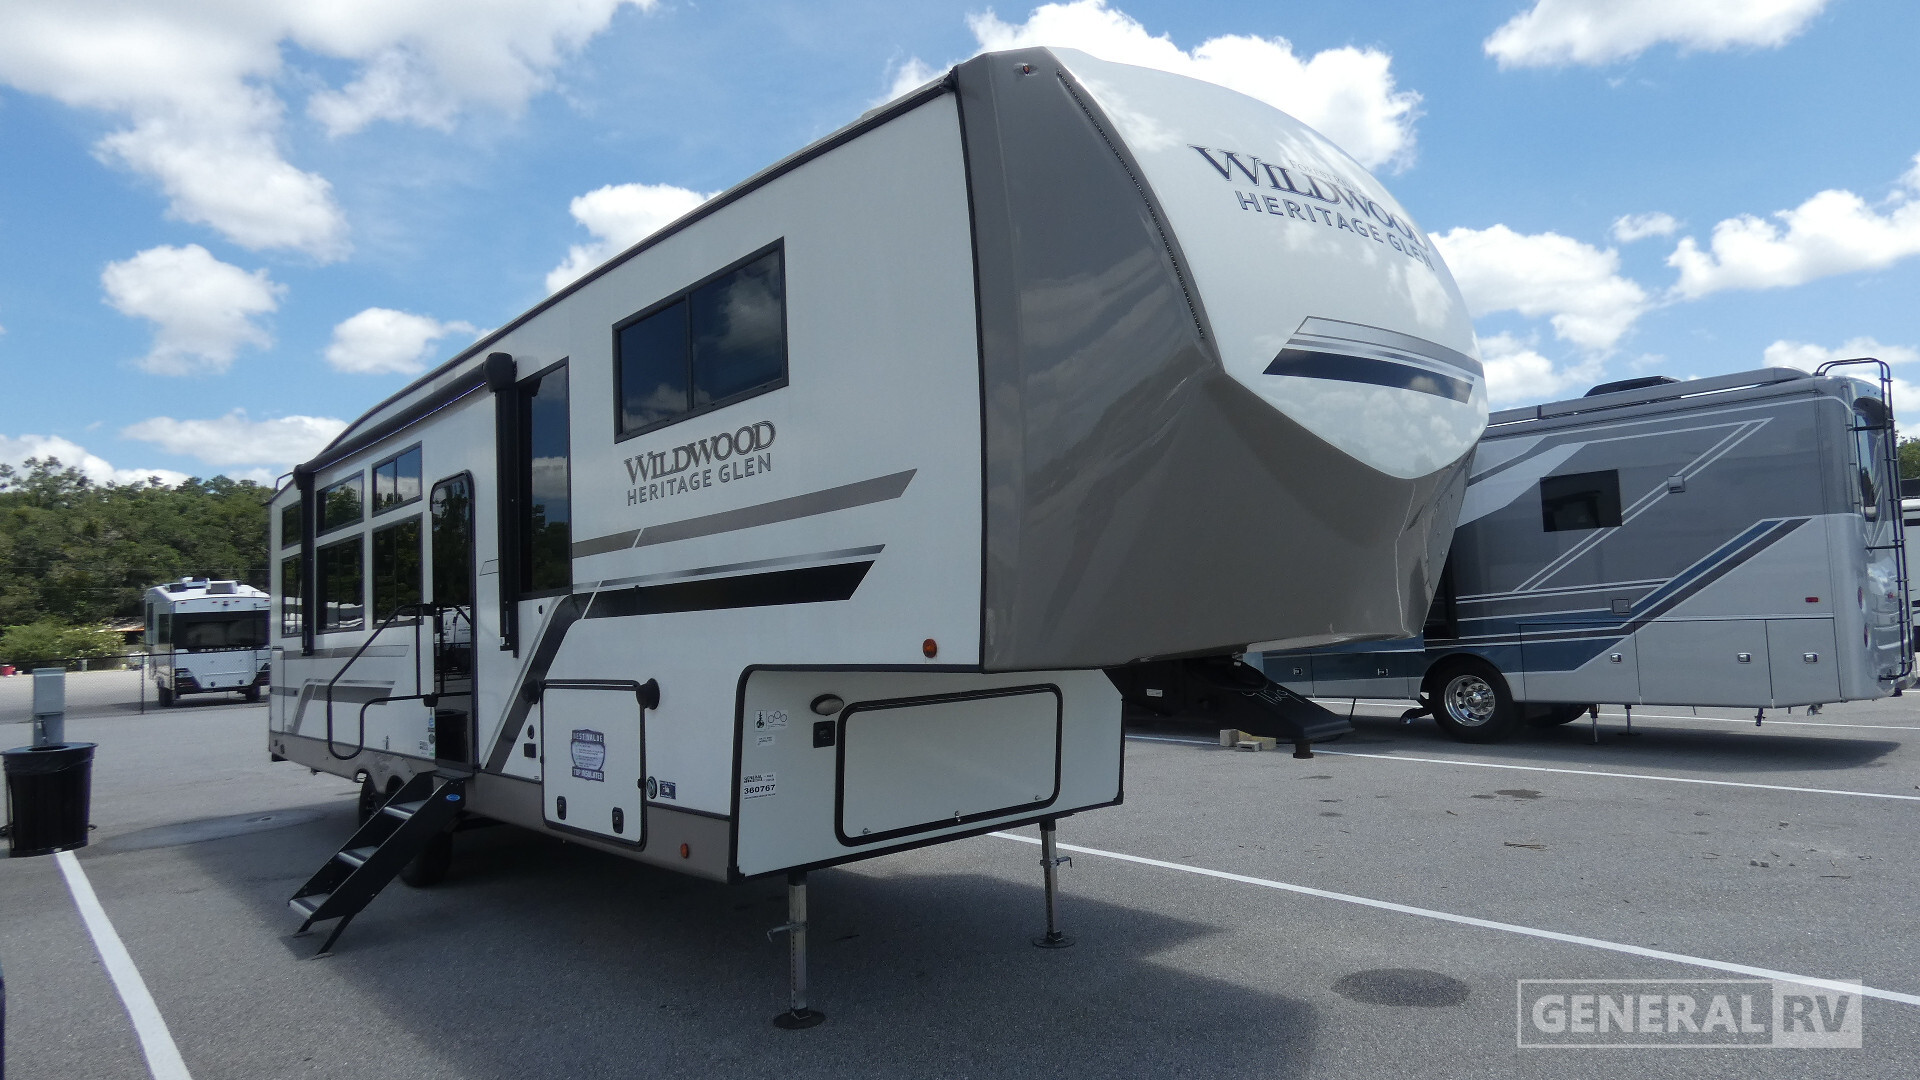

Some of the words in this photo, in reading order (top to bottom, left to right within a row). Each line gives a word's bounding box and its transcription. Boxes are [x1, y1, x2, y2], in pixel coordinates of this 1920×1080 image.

[1187, 143, 1429, 251] WILDWOOD
[1235, 190, 1384, 244] HERITAGE
[1386, 231, 1435, 272] GLEN
[624, 420, 776, 485] WILDWOOD
[627, 469, 712, 506] HERITAGE
[718, 453, 772, 483] GLEN
[743, 784, 776, 795] 360767
